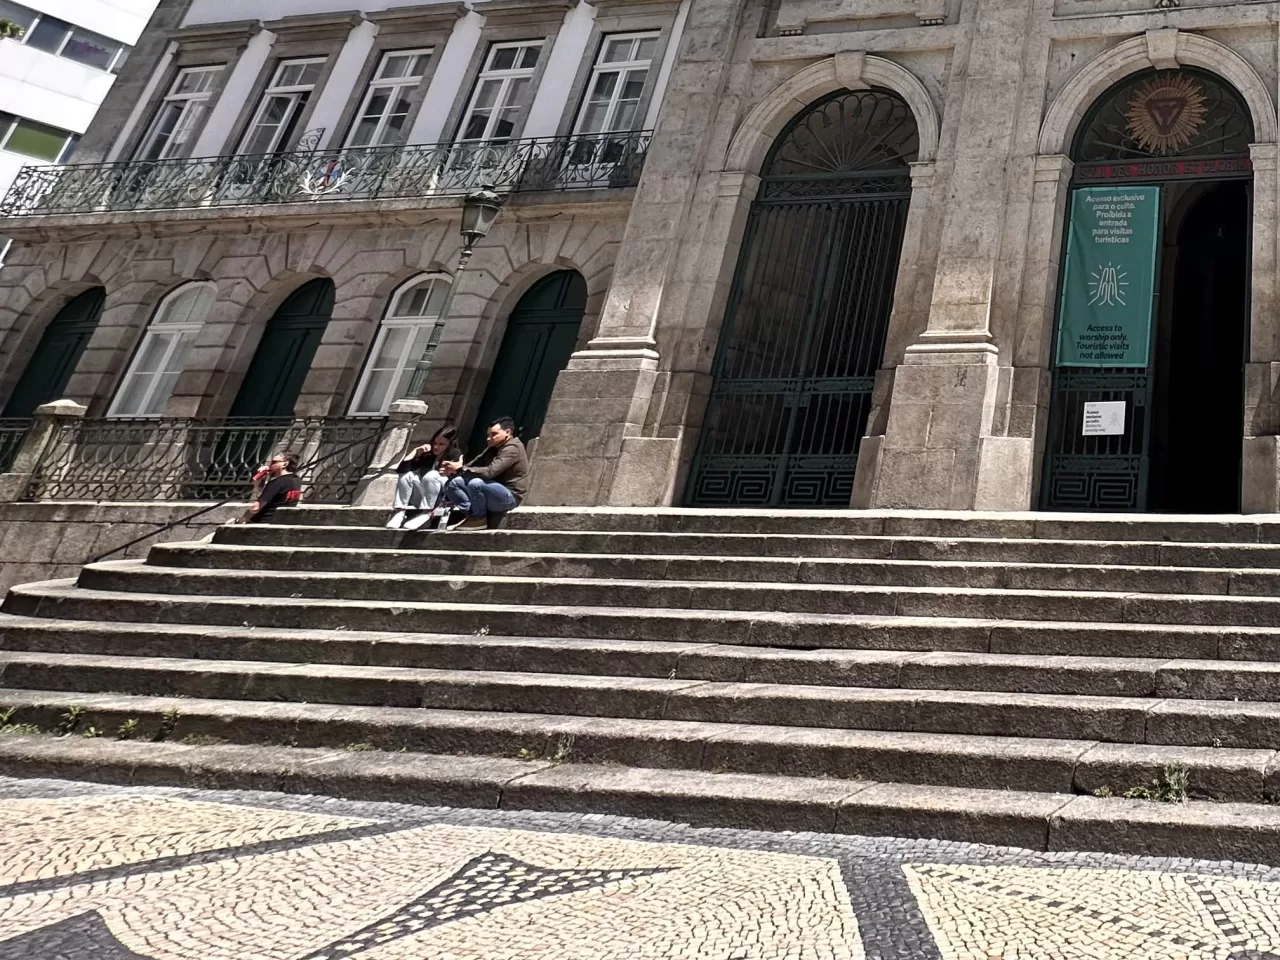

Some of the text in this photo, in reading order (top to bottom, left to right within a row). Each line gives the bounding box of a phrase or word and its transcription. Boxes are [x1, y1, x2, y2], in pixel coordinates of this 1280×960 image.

[1137, 163, 1179, 176] HONOR
[1085, 193, 1145, 203] Acesso exclusivo
[1098, 219, 1128, 227] entrada
[1092, 227, 1133, 236] para visitas
[1086, 324, 1123, 332] Access to
[1079, 332, 1128, 344] worship only.
[1076, 341, 1130, 350] Touristic visits
[1094, 351, 1125, 360] allowed
